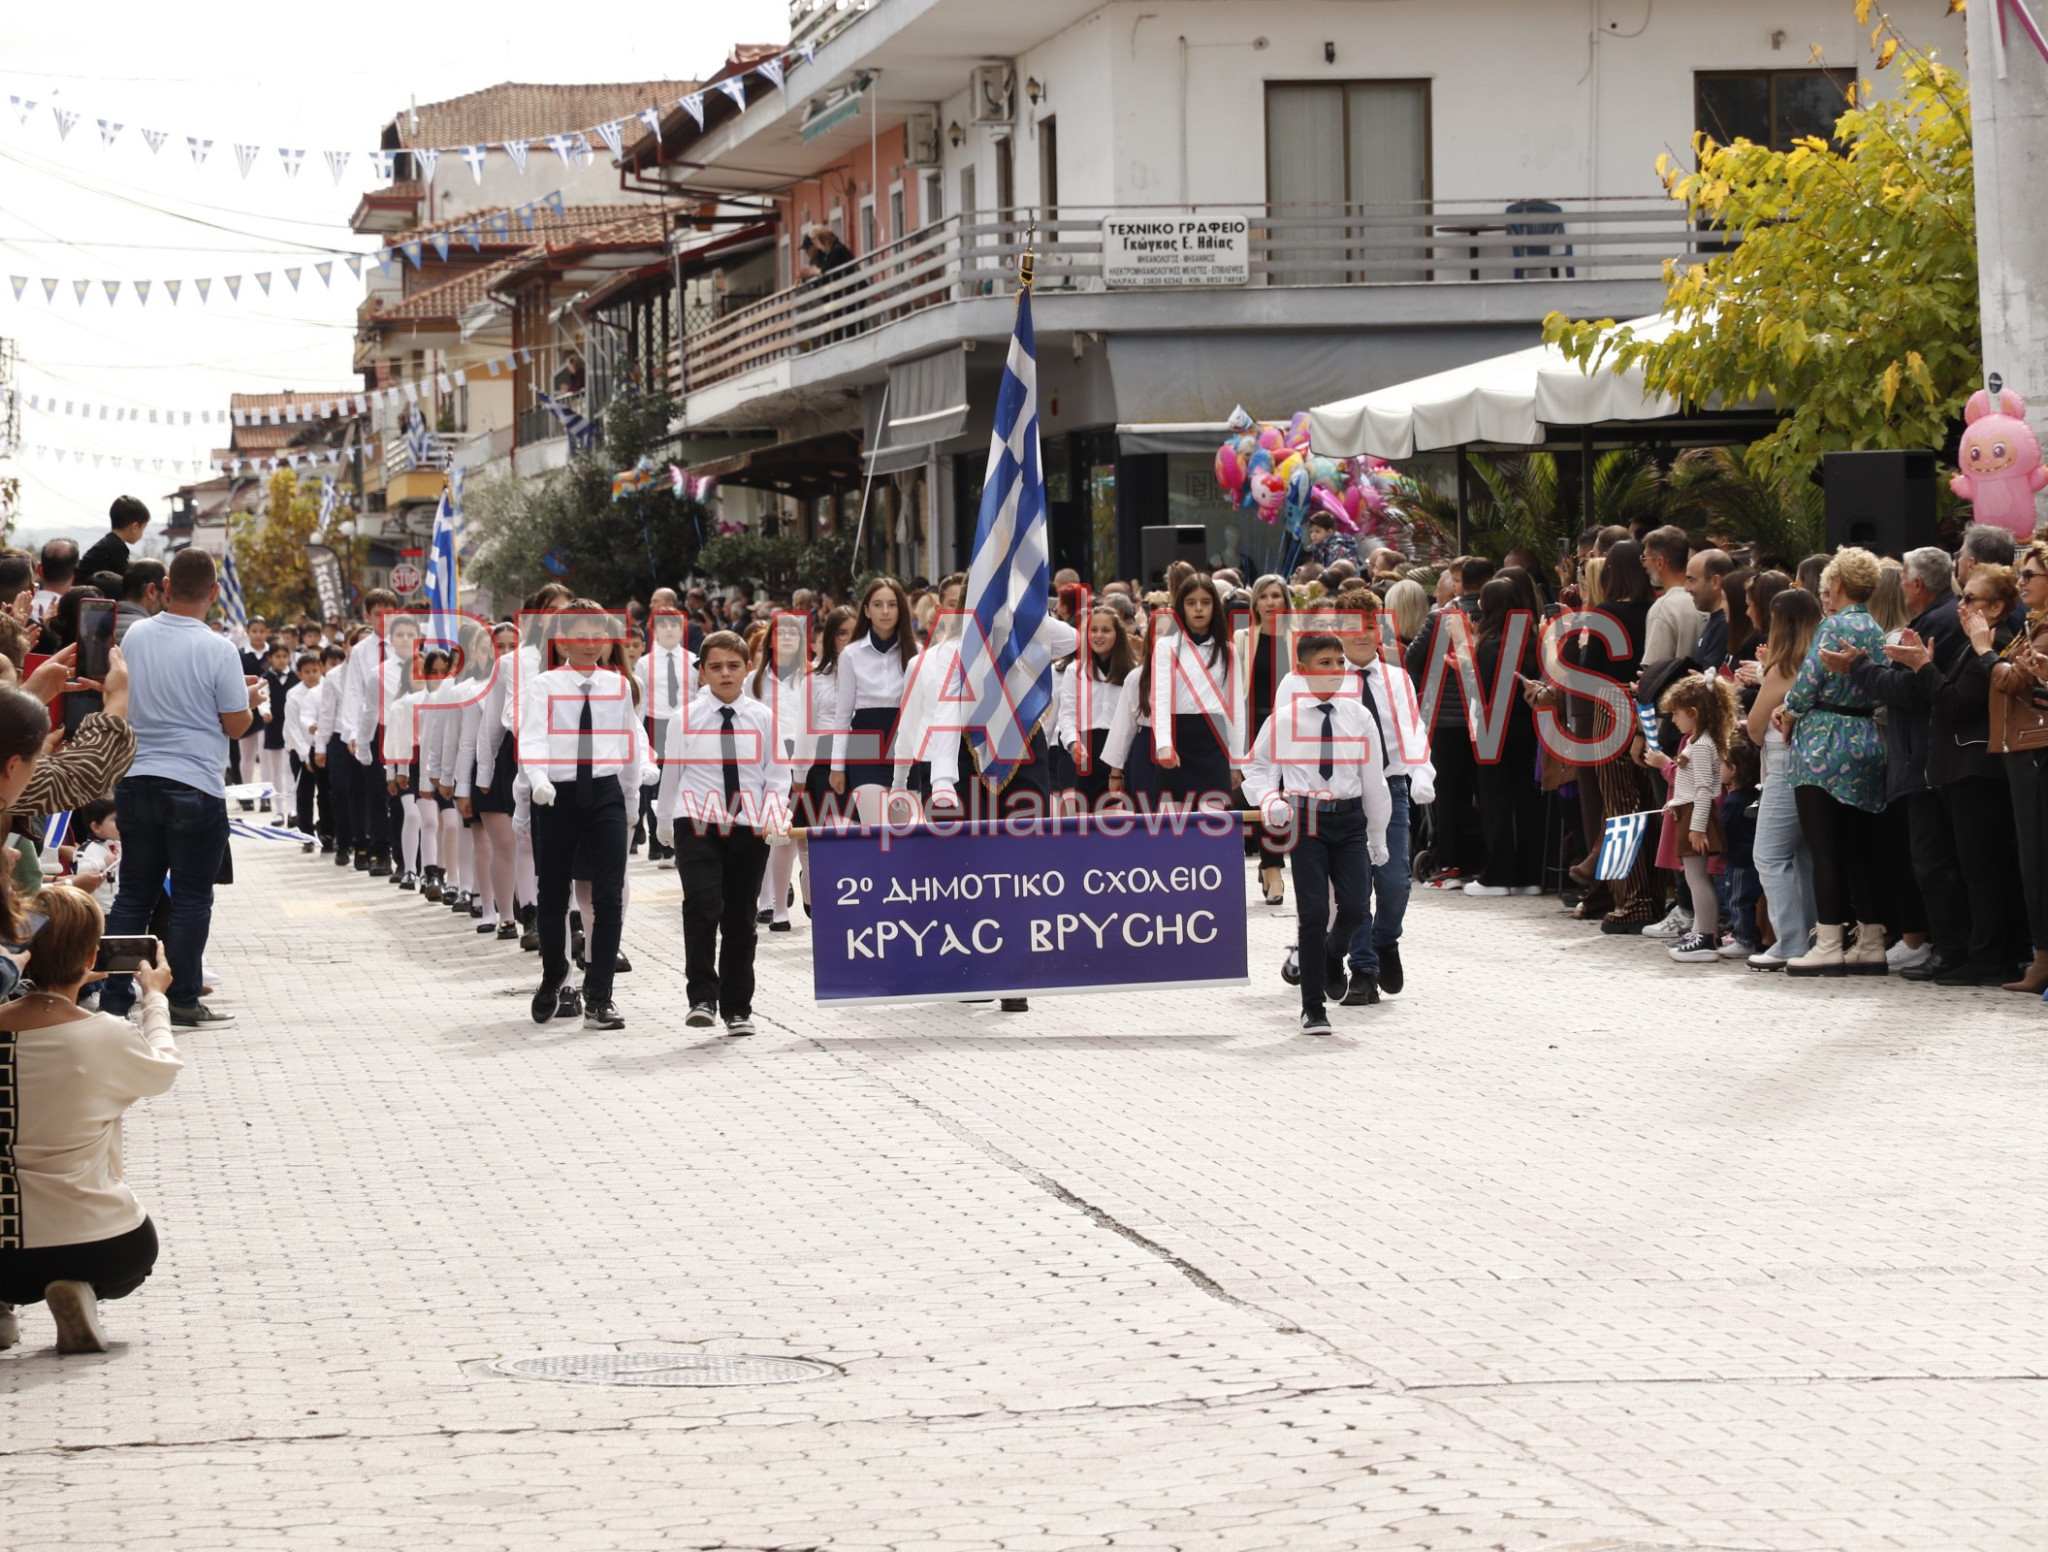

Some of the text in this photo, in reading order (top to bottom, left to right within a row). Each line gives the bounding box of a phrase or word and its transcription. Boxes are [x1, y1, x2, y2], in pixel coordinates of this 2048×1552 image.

[1109, 222, 1245, 235] ΤΕΧΝΙΚΟ ΓΡΑΦΕΙΟ
[1123, 236, 1178, 253] Γκώγκος
[1198, 235, 1234, 250] Ηλίας
[392, 571, 419, 587] STOP
[882, 870, 1066, 904] ΔΗΜΟΤΙΚΟ
